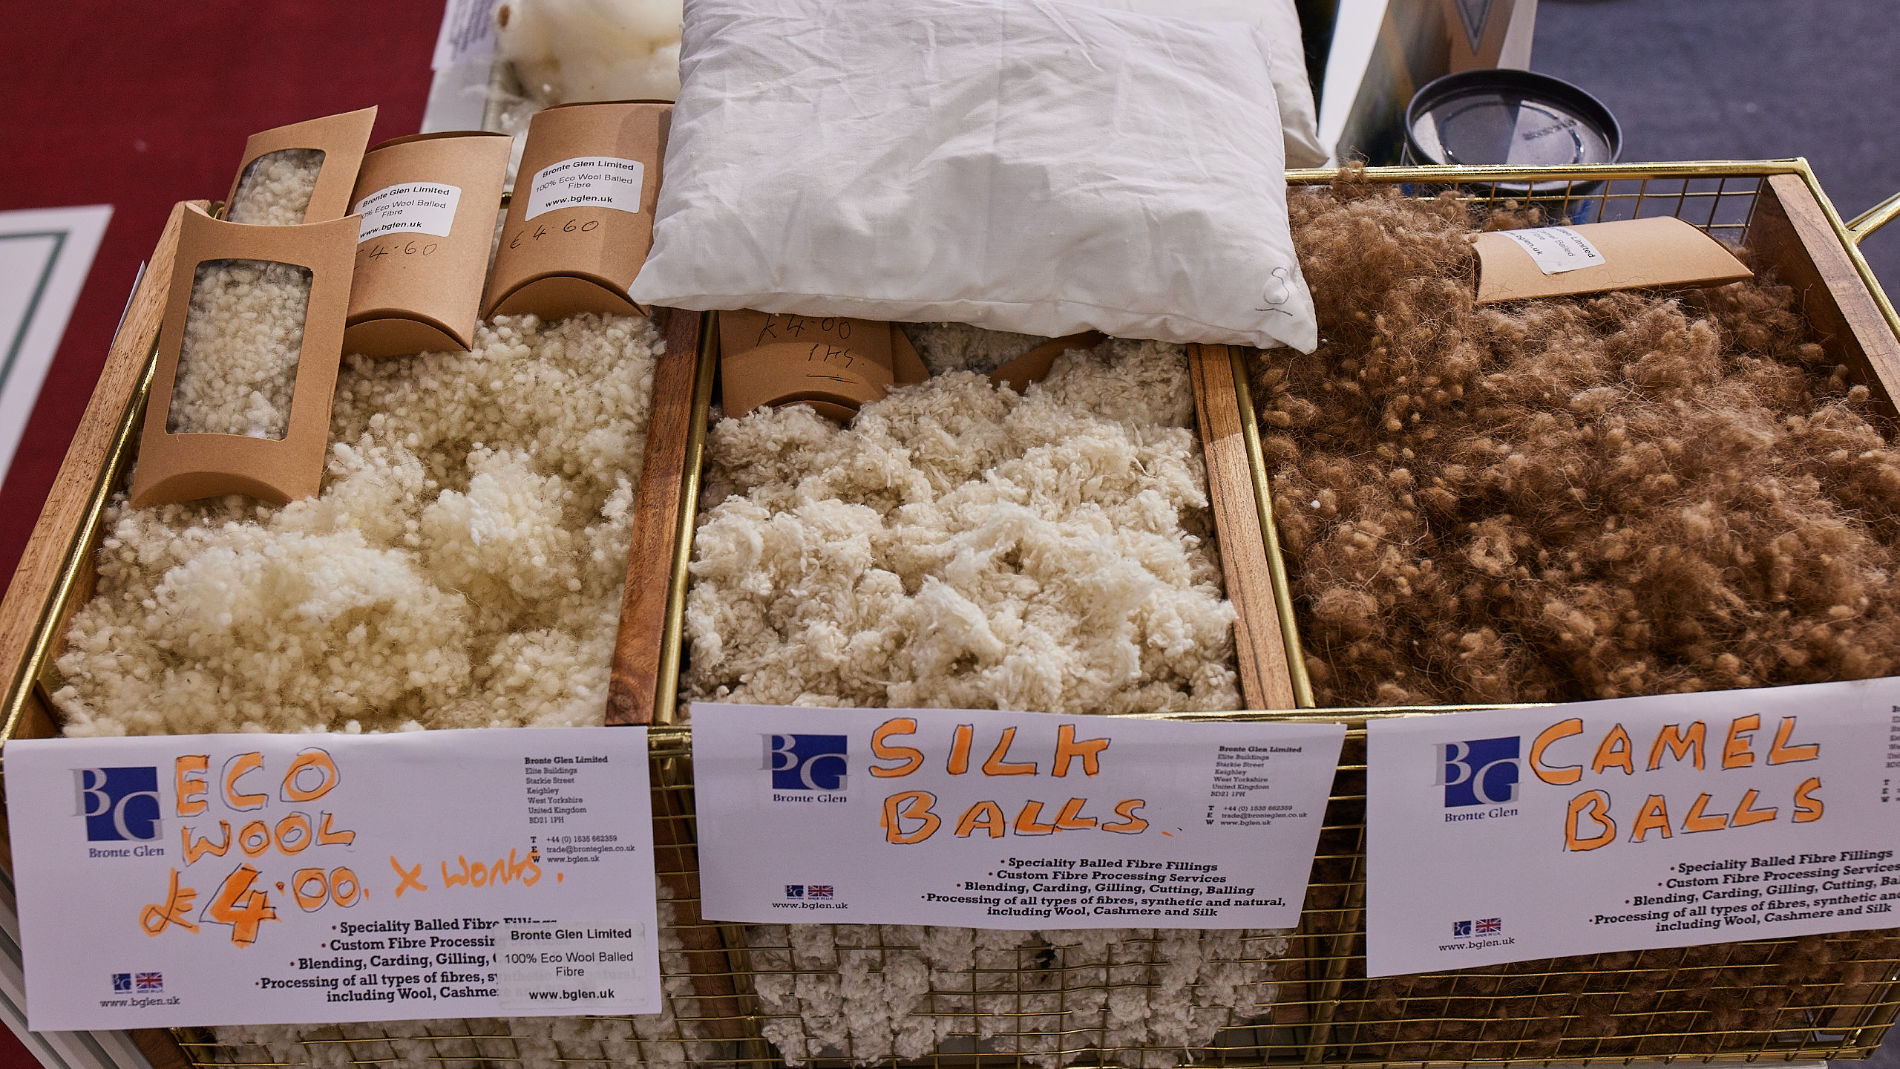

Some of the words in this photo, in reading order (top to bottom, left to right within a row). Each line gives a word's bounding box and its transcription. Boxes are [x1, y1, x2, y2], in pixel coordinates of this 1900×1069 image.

[542, 164, 570, 178] Bronte
[598, 161, 634, 171] Limited
[536, 180, 556, 193] 100%
[559, 175, 575, 184] Eco
[578, 173, 602, 181] Wool
[604, 174, 633, 184] Balled
[568, 182, 591, 190] Fibre
[362, 192, 388, 208] Bronte
[389, 187, 410, 196] Glen
[412, 186, 450, 196] Limited
[545, 195, 613, 208] www.bglen.uk
[375, 204, 390, 214] Eco
[392, 200, 415, 208] Wool
[417, 200, 447, 209] Balled
[381, 209, 403, 218] Fibre
[360, 221, 422, 239] www.bglen.uk
[868, 717, 1111, 778] SILK
[1529, 713, 1820, 785] CAMEL
[524, 757, 552, 765] Bronte
[554, 756, 573, 764] Glen
[575, 756, 608, 764] Limited
[757, 734, 851, 791] BG
[525, 767, 542, 775] Elite
[543, 767, 577, 776] Buildings
[1432, 740, 1522, 805] BG
[175, 747, 341, 817] ECO
[527, 787, 559, 796] Keighley
[773, 794, 813, 803] Bronte
[817, 794, 847, 803] Glen
[68, 768, 168, 842] BG
[554, 807, 587, 816] Kingdom
[1445, 809, 1486, 822] Bronte
[1488, 807, 1518, 818] Glen
[1563, 776, 1824, 852] BALLS
[181, 810, 356, 867] WOOL
[561, 836, 572, 844] (0)
[89, 847, 131, 858] Bronte
[133, 846, 164, 858] Glen
[546, 845, 636, 854] trade@bronteglen.co.uk
[547, 855, 600, 864] www.bglen.uk
[1008, 858, 1076, 869] Speciality
[1079, 858, 1122, 868] Balled
[1126, 859, 1163, 869] Fibre
[1165, 861, 1218, 873] Fillings
[1678, 859, 1747, 875] Speciality
[1751, 856, 1795, 867] Balled
[1799, 854, 1837, 865] Fibre
[1840, 850, 1893, 862] Fillings
[996, 870, 1048, 880] Custom
[1052, 871, 1088, 880] Fibre
[1092, 872, 1166, 883] Processing
[1169, 873, 1227, 883] Services
[1666, 877, 1719, 888] Custom
[1723, 874, 1759, 884] Fibre
[1763, 868, 1840, 881] Processing
[1843, 864, 1900, 875] Services
[964, 882, 1029, 894] Blending,
[1032, 883, 1092, 894] Carding,
[1095, 883, 1145, 894] Gilling,
[1149, 885, 1203, 896] Cutting,
[1206, 886, 1255, 896] Balling
[1633, 893, 1699, 906] Blending,
[1702, 887, 1762, 900] Carding,
[1766, 883, 1818, 895] Gilling,
[1822, 879, 1877, 892] Cutting,
[772, 902, 848, 910] www.bglen.uk
[927, 893, 1000, 906] Processing
[1004, 896, 1017, 905] of
[1020, 896, 1038, 905] all
[1040, 897, 1077, 907] types
[1080, 896, 1094, 905] of
[1096, 896, 1138, 906] fibres,
[1141, 897, 1203, 907] synthetic
[1205, 898, 1231, 907] and
[1233, 898, 1286, 908] natural,
[987, 907, 1052, 918] including
[1055, 907, 1090, 916] Wool,
[1093, 907, 1161, 916] Cashmere
[1164, 908, 1189, 916] and
[1192, 908, 1218, 917] Silk
[1595, 910, 1670, 925] Processing
[1673, 907, 1687, 918] of
[1690, 906, 1706, 916] all
[1710, 904, 1747, 917] types
[1751, 901, 1764, 912] of
[1767, 899, 1810, 911] fibres,
[1813, 892, 1876, 908] synthetic
[1656, 918, 1721, 932] including
[1724, 914, 1761, 926] Wool,
[1764, 910, 1834, 923] Cashmere
[1837, 905, 1862, 916] and
[1866, 903, 1892, 914] Silk
[340, 920, 411, 936] Speciality
[414, 919, 460, 931] Balled
[511, 930, 552, 941] Bronte
[555, 929, 583, 939] Glen
[587, 928, 632, 939] Limited
[330, 938, 385, 951] Custom
[388, 936, 427, 948] Fibre
[1439, 937, 1515, 951] www.bglen.uk
[298, 957, 367, 971] Blending,
[370, 955, 433, 969] Carding,
[436, 953, 490, 968] Gilling,
[505, 953, 537, 964] 100%
[541, 952, 562, 963] Eco
[566, 952, 595, 963] Wool
[599, 951, 634, 962] Balled
[556, 966, 585, 977] Fibre
[261, 976, 339, 990] Processing
[343, 974, 355, 986] of
[359, 974, 378, 986] all
[381, 973, 420, 988] types
[423, 972, 437, 983] of
[440, 971, 486, 986] fibres,
[100, 996, 180, 1008] www.bglen.uk
[327, 989, 395, 1004] including
[397, 987, 437, 1000] Wool,
[440, 986, 499, 998] Cashme
[529, 989, 615, 1001] www.bglen.uk
